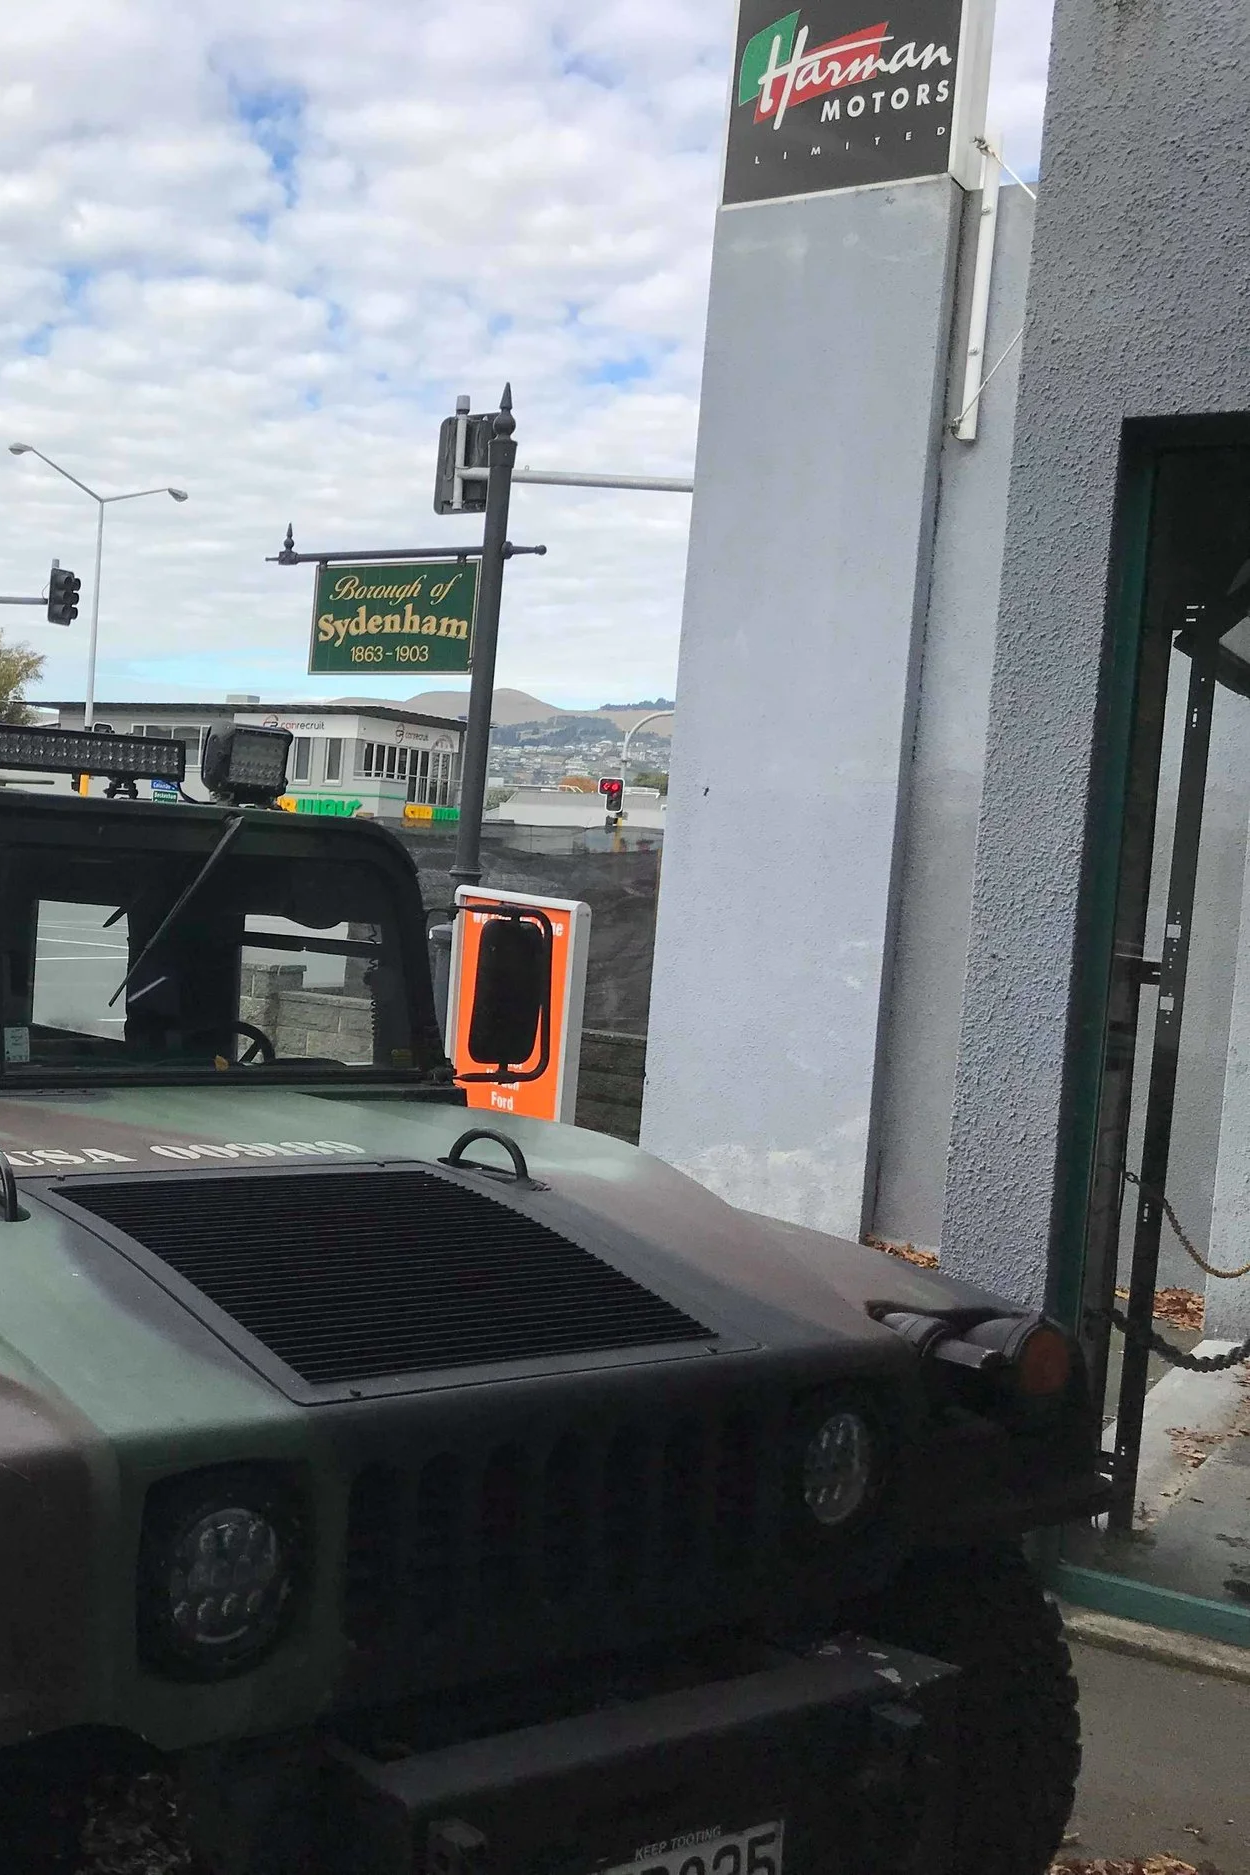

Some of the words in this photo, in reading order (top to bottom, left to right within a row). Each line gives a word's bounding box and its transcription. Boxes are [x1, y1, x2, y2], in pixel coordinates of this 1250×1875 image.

[758, 25, 952, 130] Harman
[820, 80, 950, 122] MOTORS
[754, 126, 946, 165] LIMITED
[329, 574, 427, 606] Borough
[430, 573, 463, 606] of
[317, 603, 468, 647] Sydenham
[280, 721, 325, 730] canrecruit
[491, 1091, 514, 1111] Ford
[3, 1148, 137, 1167] USA
[149, 1140, 366, 1160] 009189
[634, 1841, 668, 1861] KEEP
